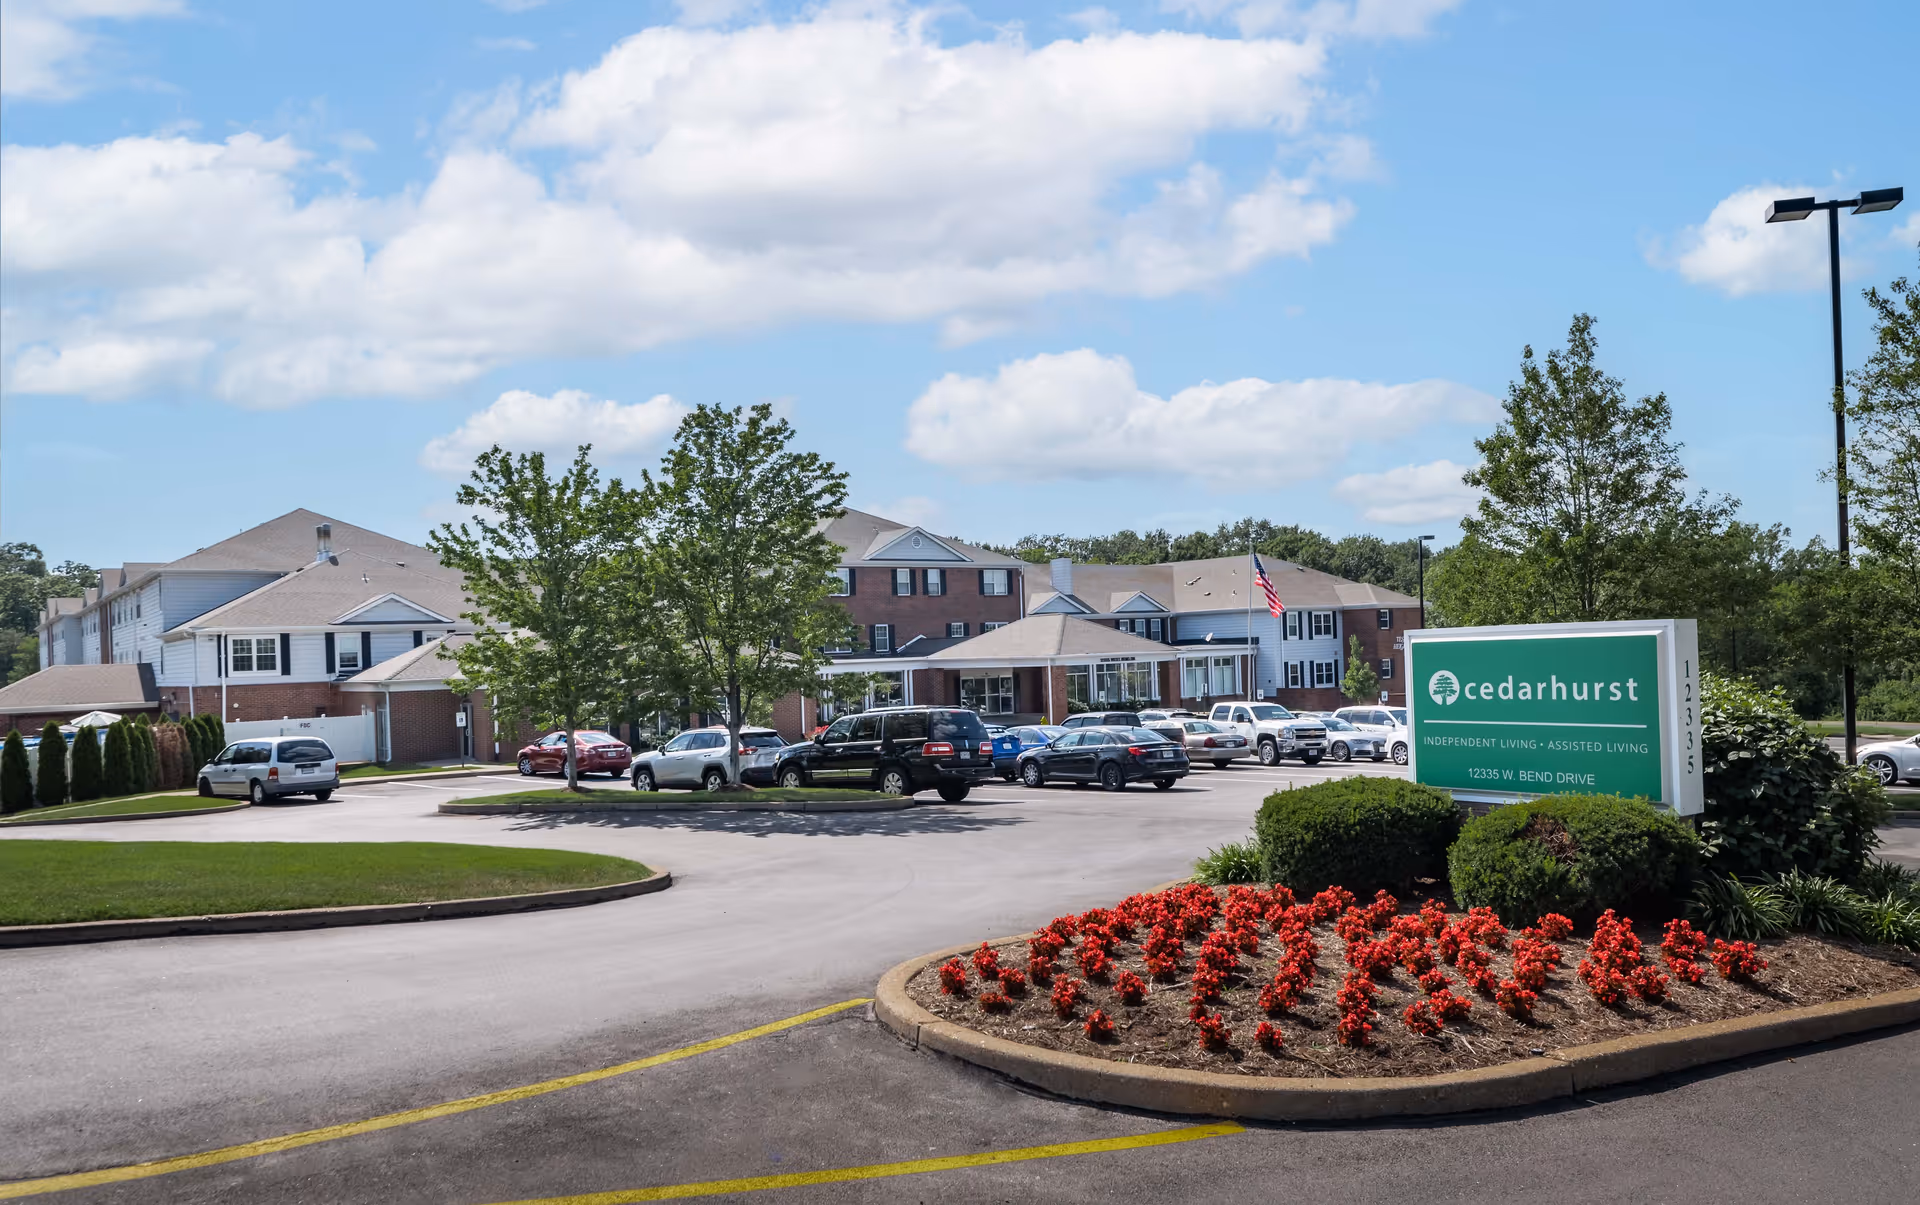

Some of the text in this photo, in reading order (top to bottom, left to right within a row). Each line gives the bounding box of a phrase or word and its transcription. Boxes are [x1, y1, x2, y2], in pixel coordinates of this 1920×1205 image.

[1464, 675, 1639, 701] cedarhurst
[1684, 659, 1694, 774] 12335
[1423, 736, 1648, 754] INDEPENDENT LIVING ASSISTED LIVING
[1468, 767, 1595, 785] 12335 W. BEND DRIVE
